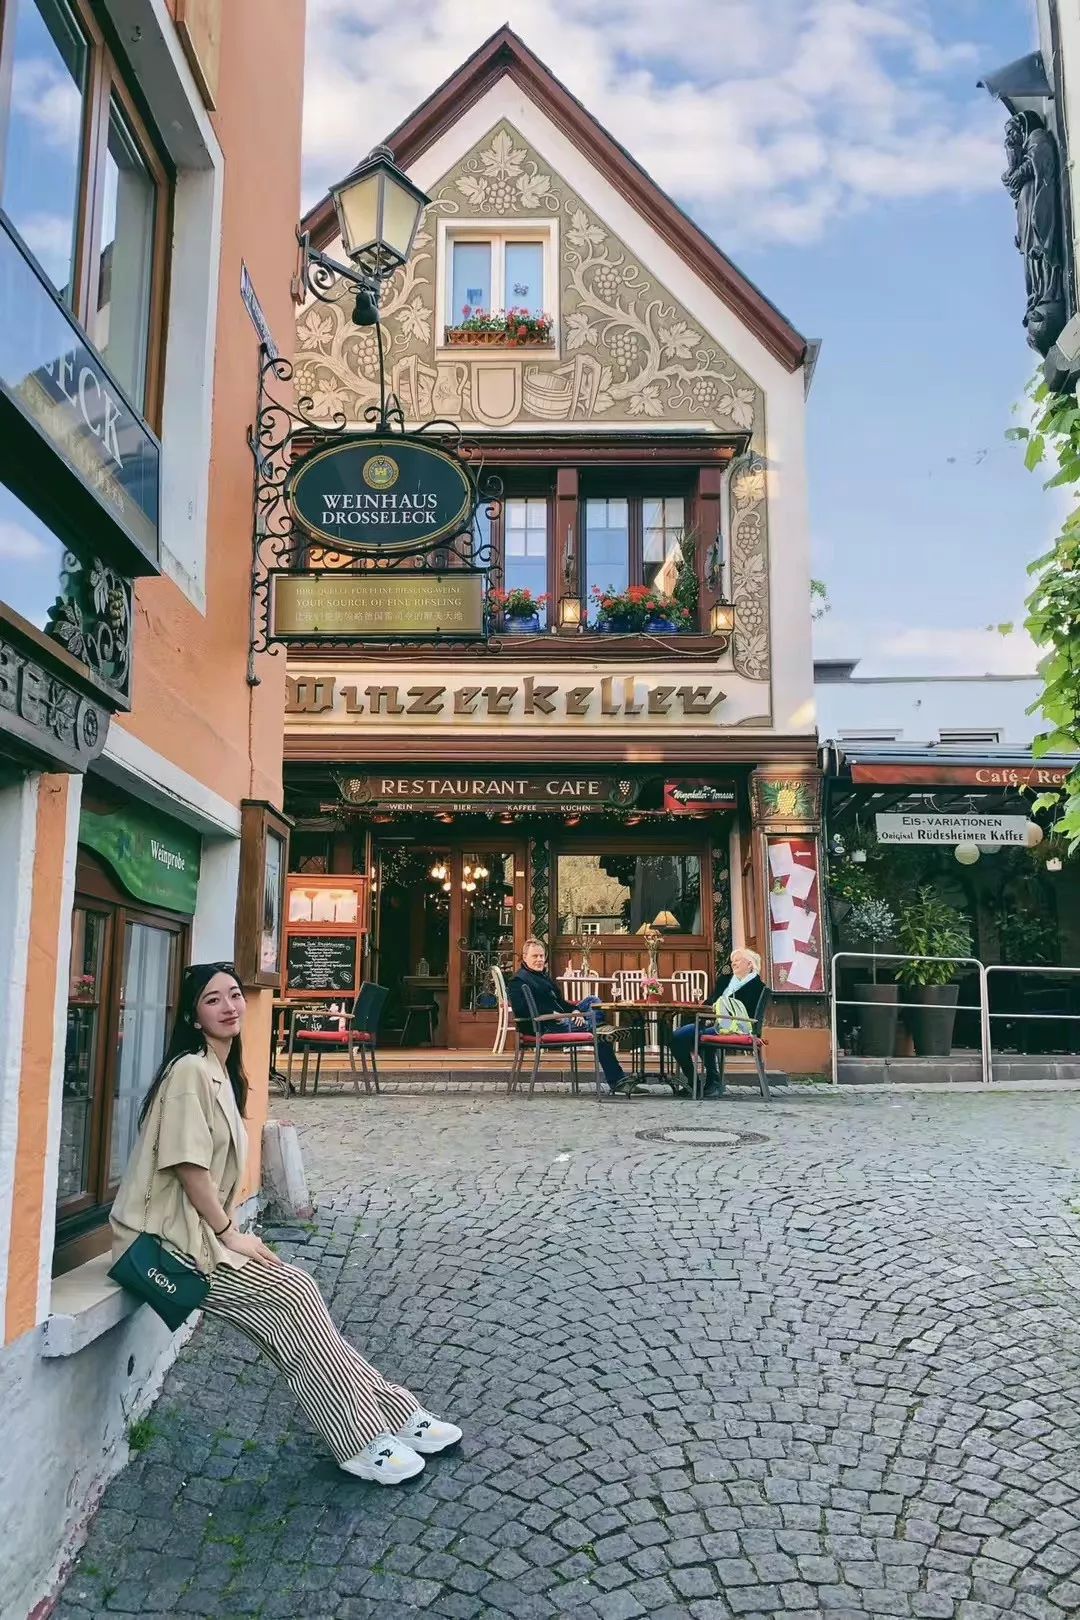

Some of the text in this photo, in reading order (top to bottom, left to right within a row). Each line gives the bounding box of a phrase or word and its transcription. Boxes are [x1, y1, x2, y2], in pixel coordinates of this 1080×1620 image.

[322, 493, 438, 509] WEINHAUS
[321, 511, 437, 525] DROSSELECK
[296, 599, 324, 607] YOUR
[327, 599, 367, 607] SOURCE
[370, 599, 384, 607] OF
[414, 598, 462, 606] RIESLING
[284, 676, 727, 714] Winzerkeller
[975, 769, 1018, 783] Café
[381, 779, 529, 795] RESTAURANT
[150, 839, 185, 870] Weinprobe
